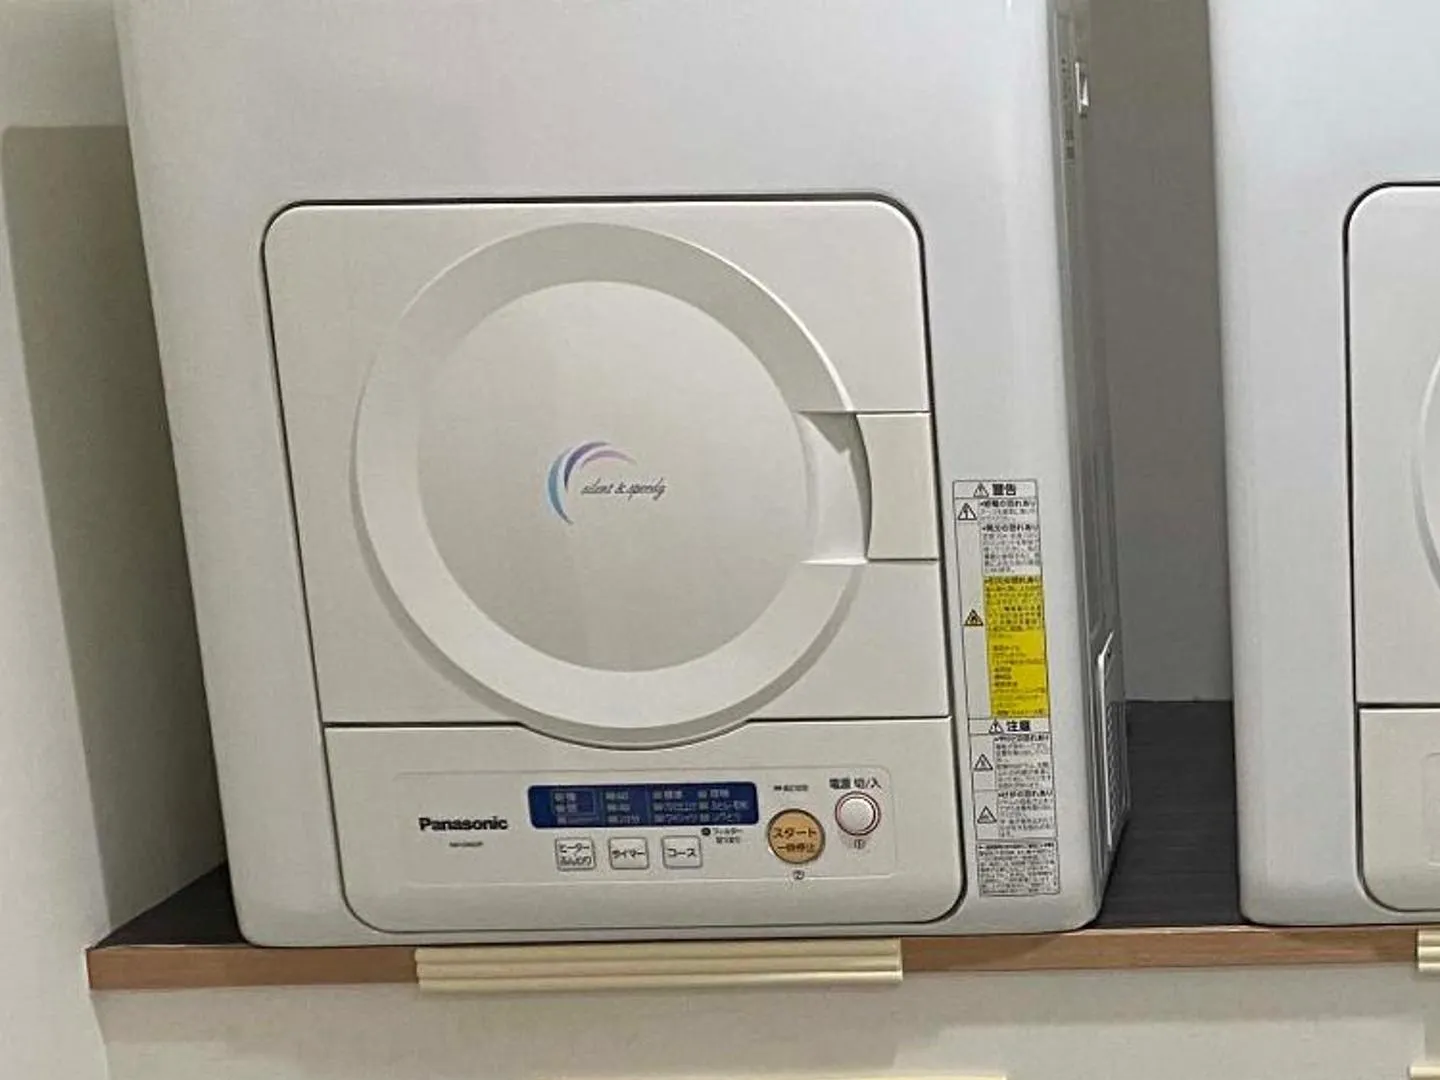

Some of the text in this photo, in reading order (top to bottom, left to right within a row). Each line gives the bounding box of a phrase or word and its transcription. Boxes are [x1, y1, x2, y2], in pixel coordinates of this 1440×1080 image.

[1006, 720, 1031, 731] 注意
[418, 816, 509, 831] Panasonic
[773, 826, 818, 839] スタート
[612, 848, 646, 860] タイマー
[667, 847, 698, 858] コース
